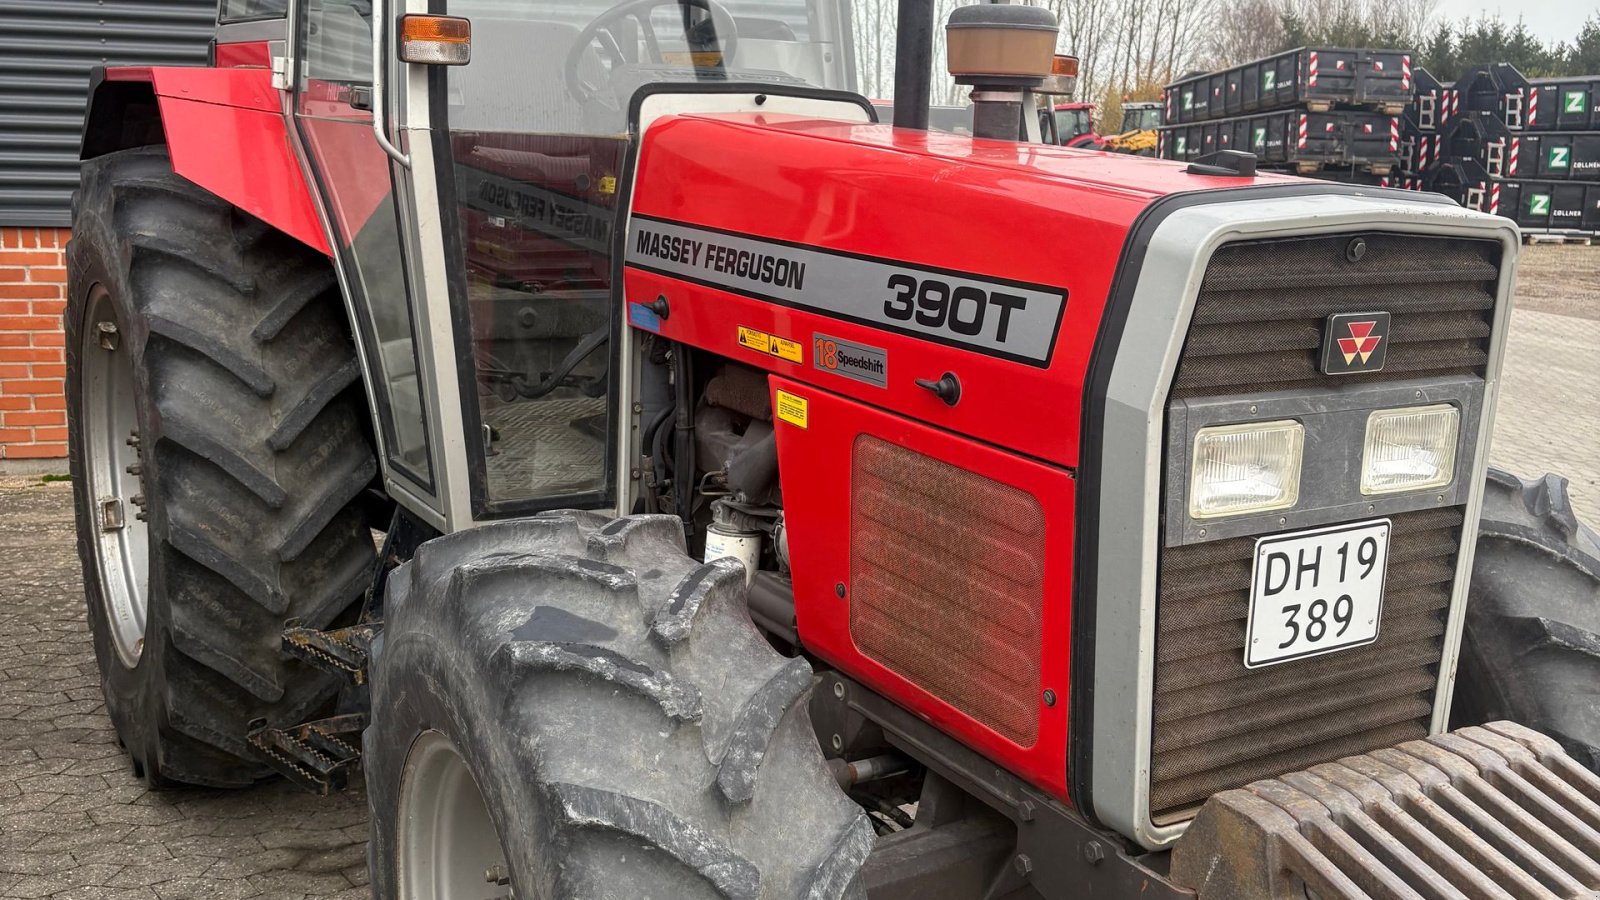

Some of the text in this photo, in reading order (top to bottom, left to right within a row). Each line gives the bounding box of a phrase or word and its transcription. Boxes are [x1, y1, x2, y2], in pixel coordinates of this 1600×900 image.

[1567, 92, 1583, 112] Z
[1551, 147, 1568, 167] Z
[1532, 194, 1549, 214] Z
[636, 230, 806, 290] MASSEY FERGUSON
[884, 274, 1027, 344] 390T
[816, 338, 838, 370] 18
[838, 350, 884, 375] Speedshift
[1264, 536, 1378, 597] DH 19
[1278, 594, 1354, 649] 389
